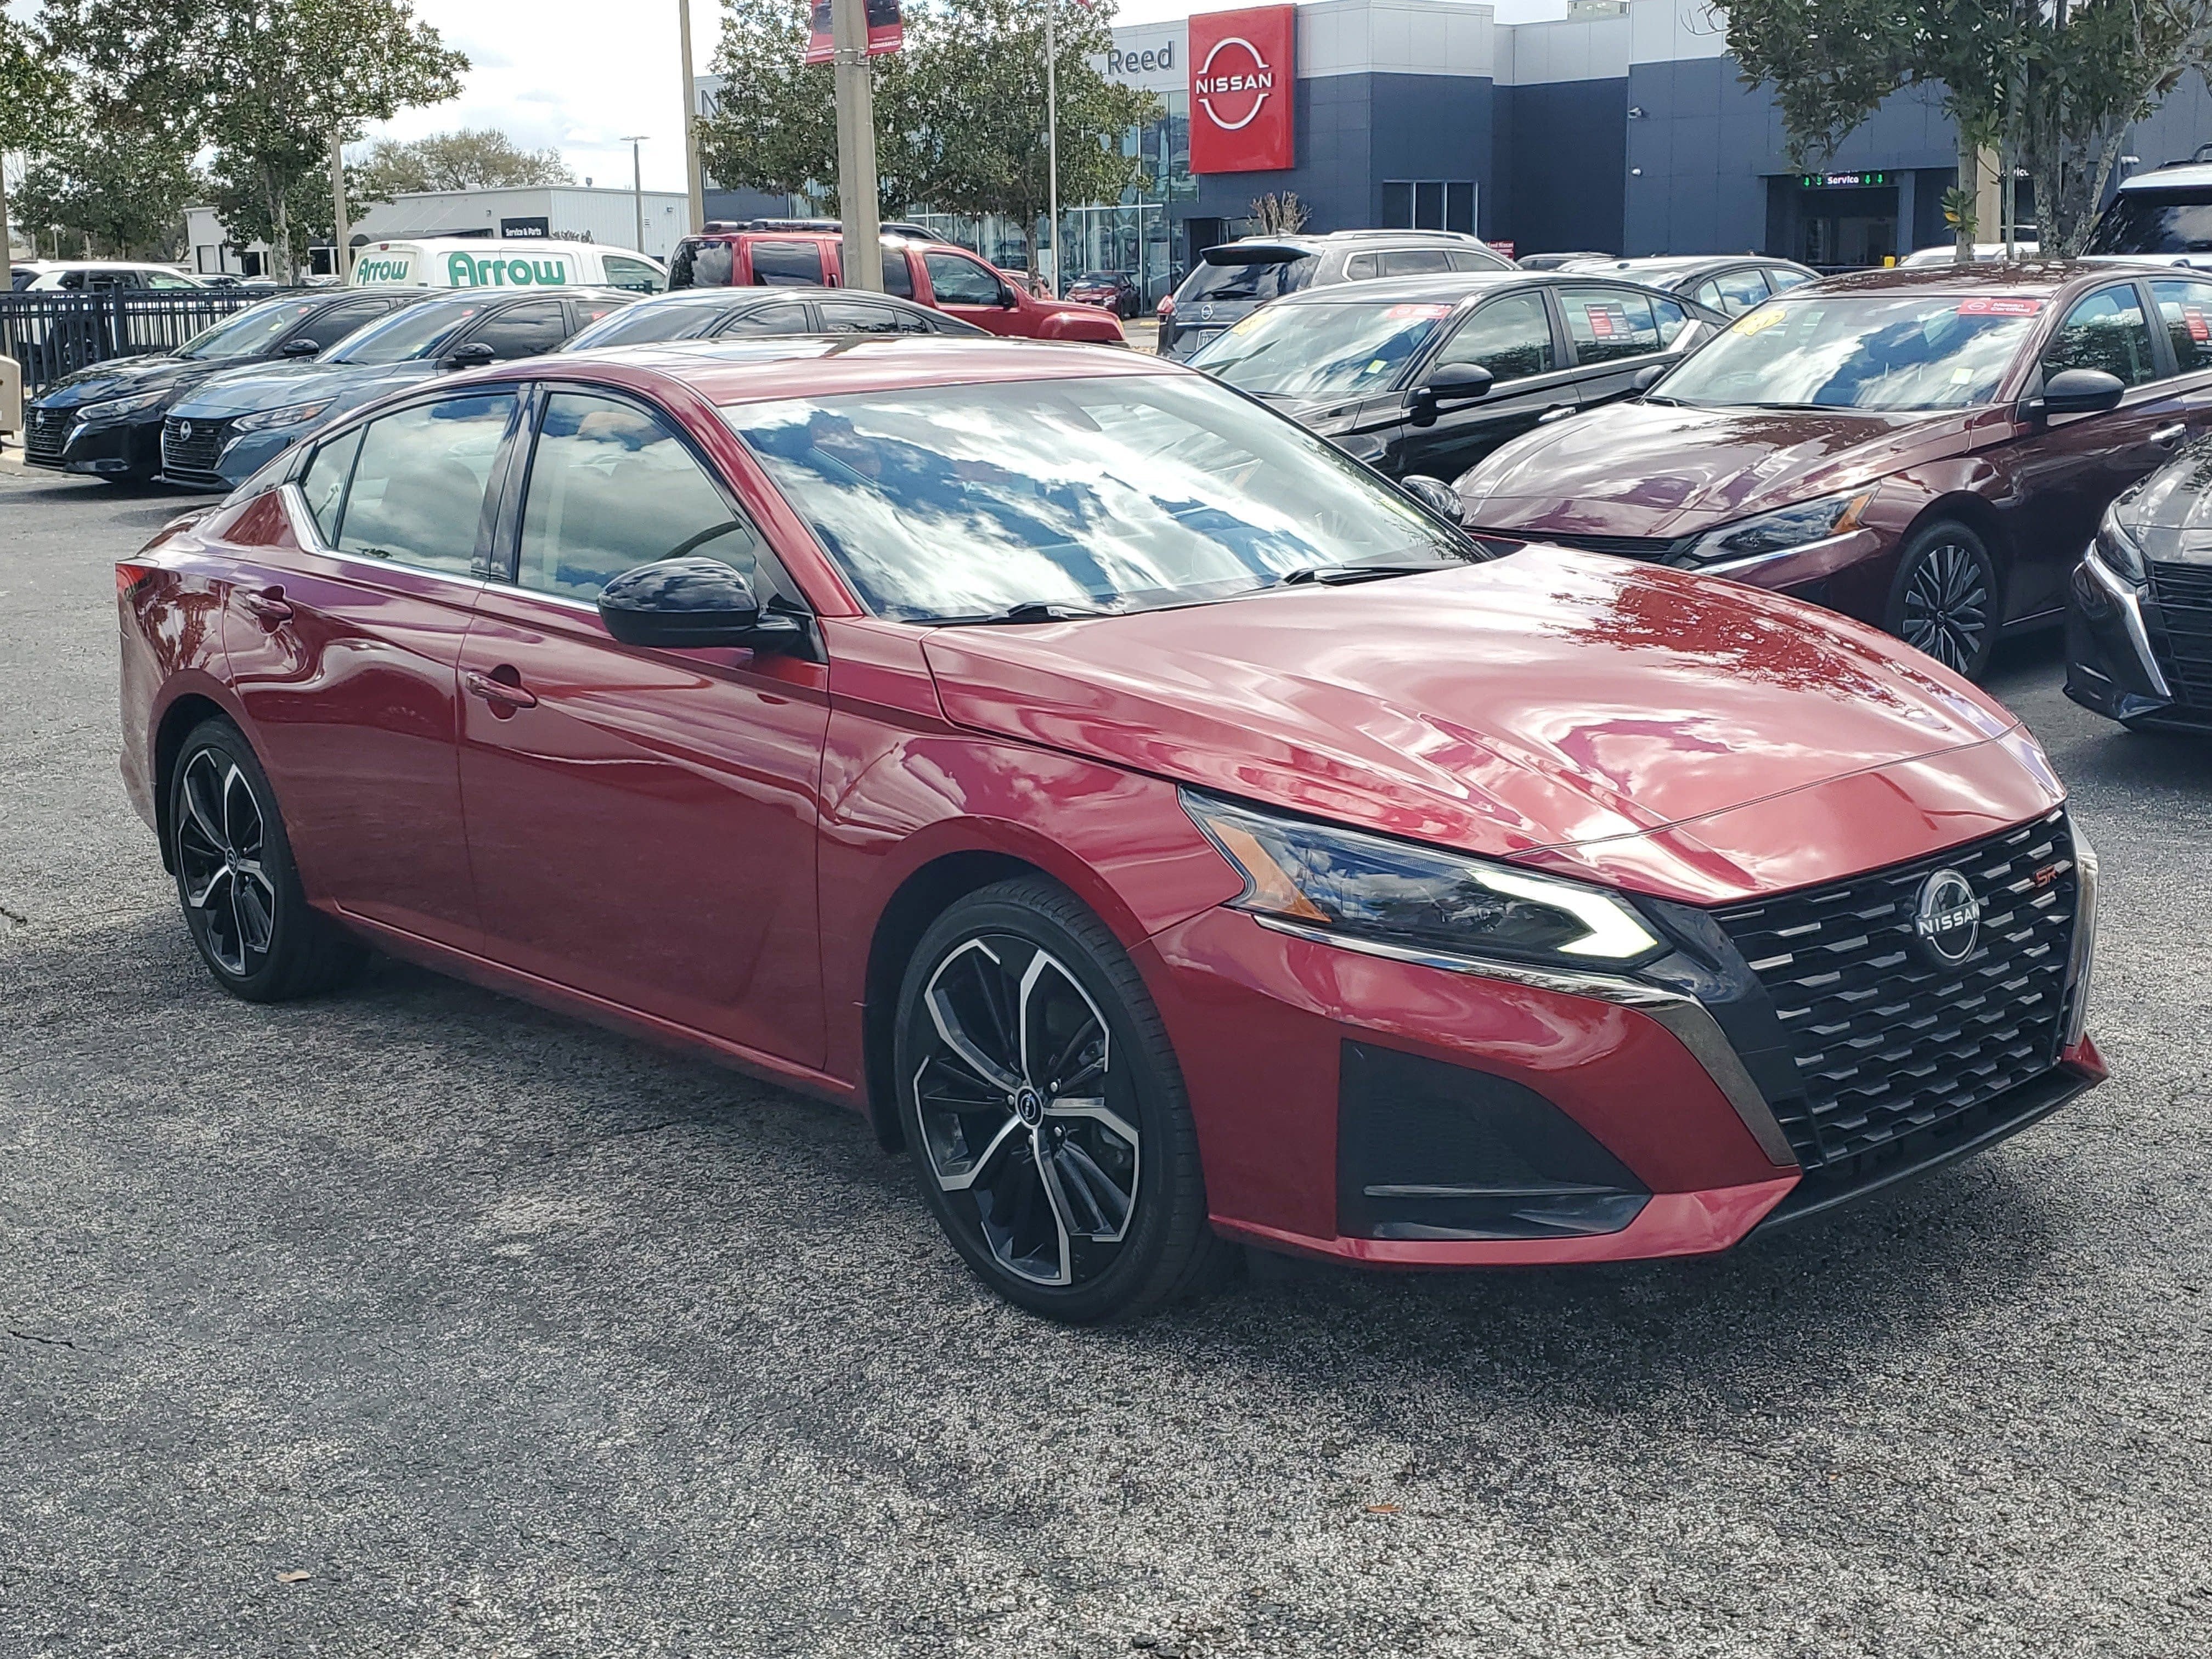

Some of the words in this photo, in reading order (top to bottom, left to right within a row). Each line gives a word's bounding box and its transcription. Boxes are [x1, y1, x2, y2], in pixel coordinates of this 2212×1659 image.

[1107, 41, 1173, 75] Reed
[1195, 72, 1272, 94] NISSAN
[1827, 175, 1860, 185] Service
[505, 228, 523, 236] Service
[528, 227, 542, 236] Parts
[357, 257, 409, 286] Arrow
[448, 251, 566, 286] Arrow
[2035, 865, 2057, 888] SR
[1919, 901, 1980, 935] NISSAN
